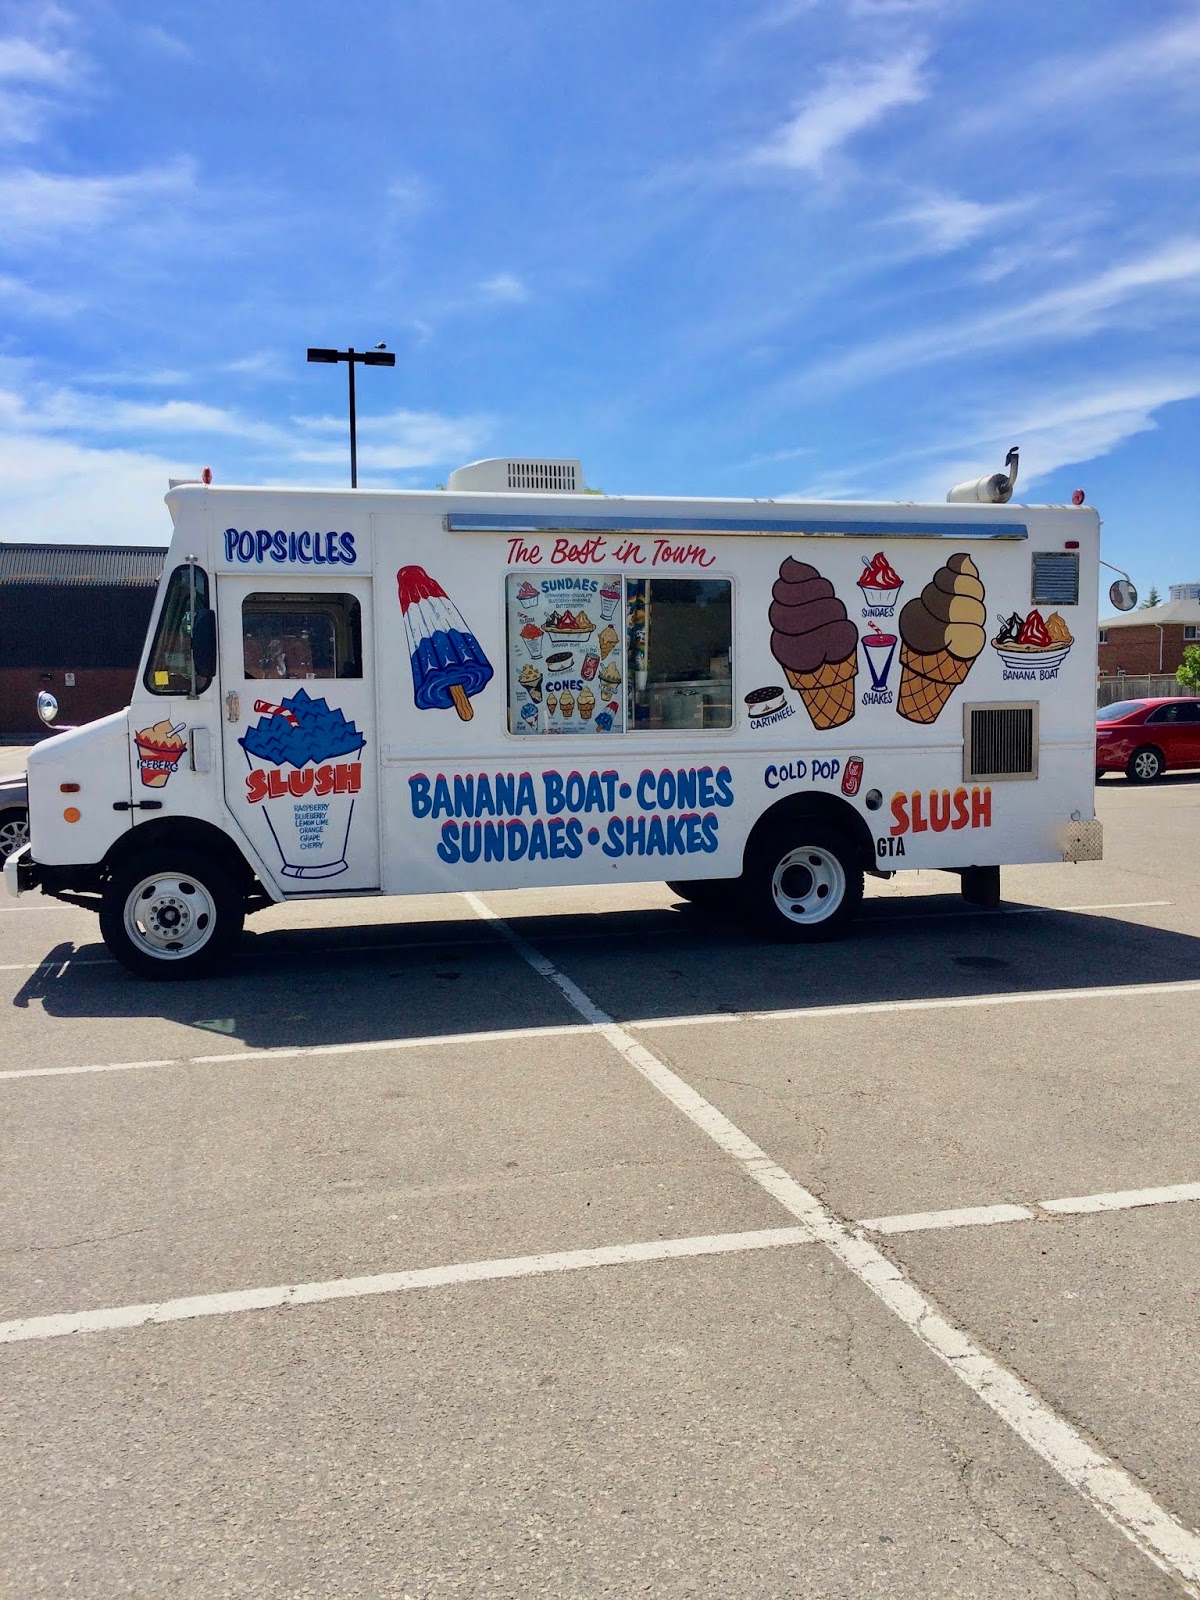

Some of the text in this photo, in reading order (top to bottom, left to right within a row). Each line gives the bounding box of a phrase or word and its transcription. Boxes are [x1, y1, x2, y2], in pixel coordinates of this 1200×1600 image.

[223, 528, 357, 565] POPSICLES
[507, 536, 716, 567] The Best in Town
[541, 577, 598, 593] SUNDAES
[861, 607, 895, 618] SUNDAES
[1002, 668, 1060, 681] BANANA BOAT
[545, 680, 584, 692] CONES
[861, 691, 893, 705] SHAKES
[750, 705, 796, 730] CARTWHEEL
[137, 760, 179, 772] ICEBERG
[764, 760, 807, 789] COLD
[812, 759, 840, 781] POP
[246, 763, 361, 804] SLUSH
[408, 766, 734, 818] BANANA BOAT CONES
[294, 803, 330, 812] RASPBERRY
[890, 786, 992, 836] SLUSH
[294, 812, 327, 820] BLUEBERRY
[295, 818, 329, 827] LEMON LIME
[299, 826, 324, 834] ORANGE
[437, 812, 719, 863] SUNDAES SHAKES
[300, 842, 324, 850] CHERRY
[877, 837, 906, 857] GTA
